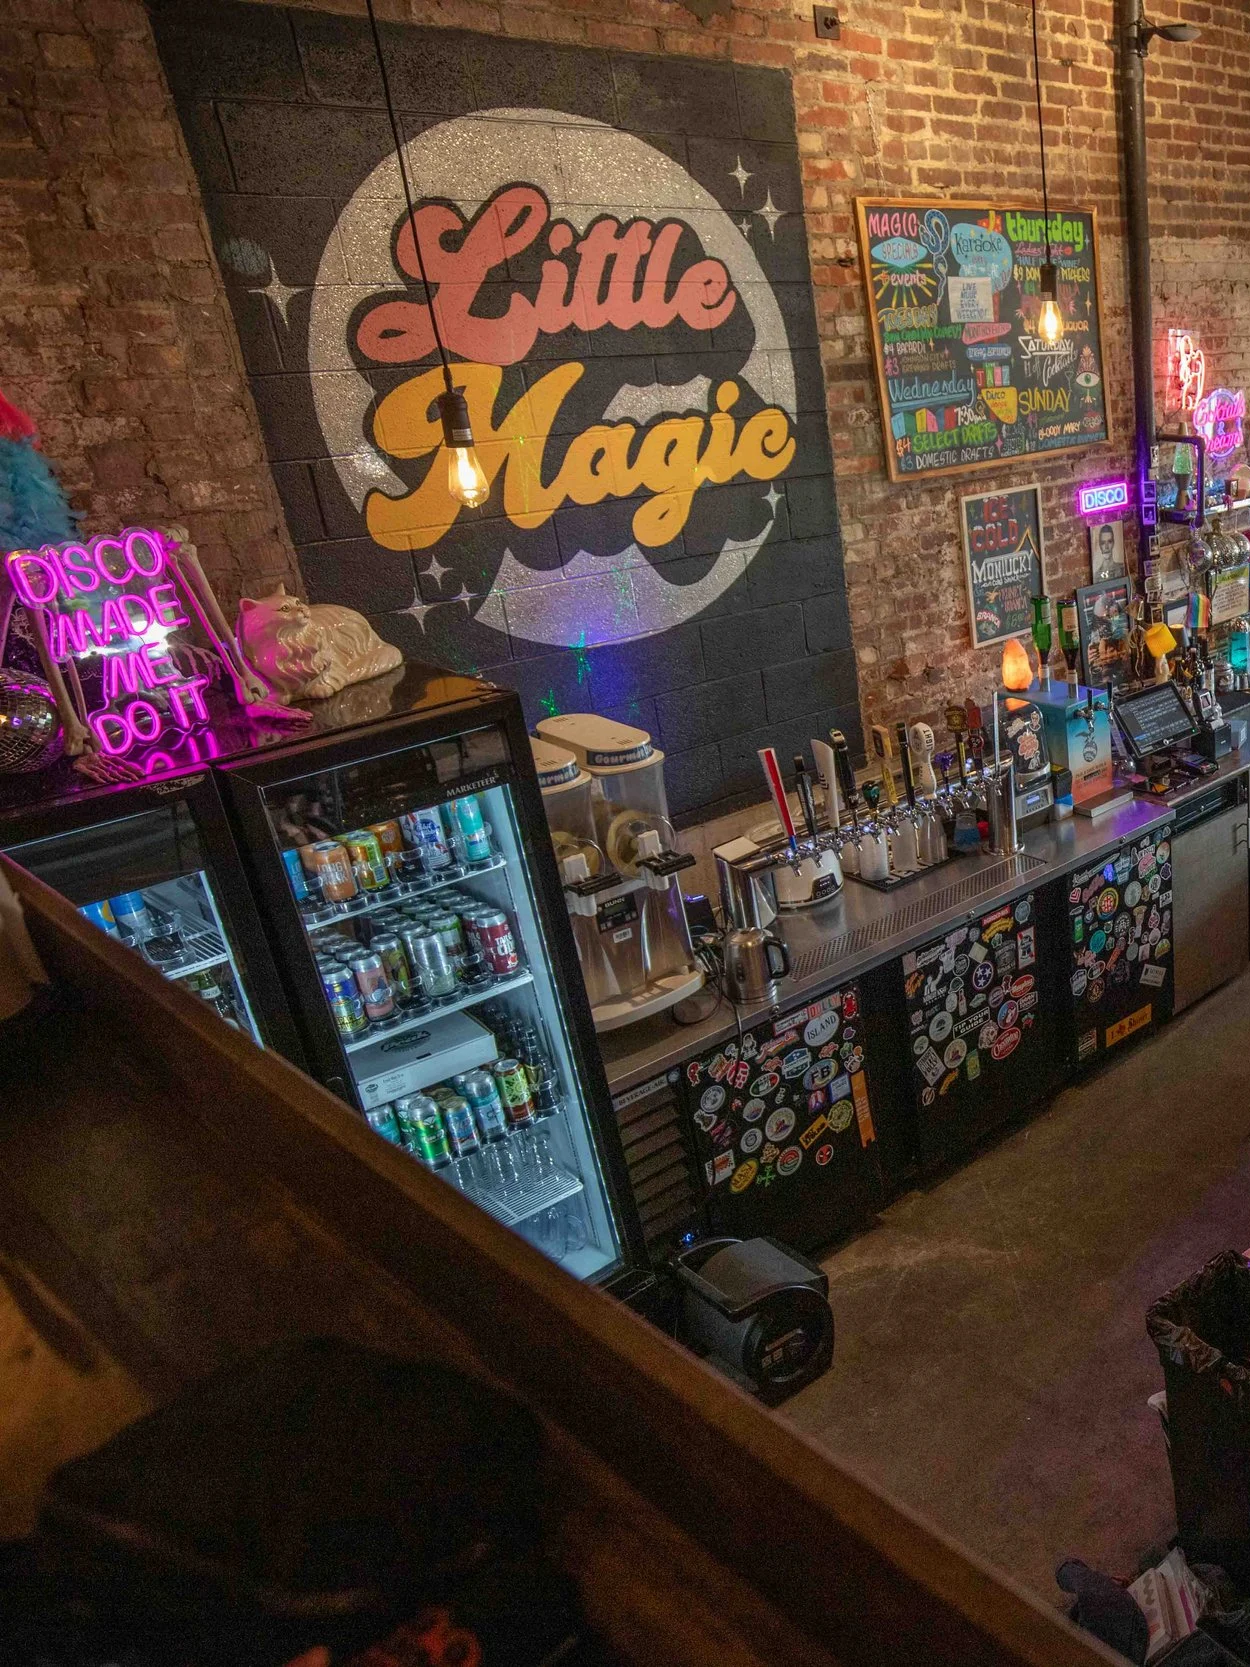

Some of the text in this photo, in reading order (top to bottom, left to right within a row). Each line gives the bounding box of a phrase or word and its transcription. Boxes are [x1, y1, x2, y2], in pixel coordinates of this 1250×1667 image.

[869, 212, 917, 237] MAGIC
[954, 233, 1002, 255] Karaoke
[357, 186, 737, 365] Little
[890, 270, 927, 287] events
[897, 340, 927, 356] BACARDI
[1043, 341, 1078, 387] Cocktails
[888, 368, 975, 407] Wednesday
[1019, 386, 1072, 415] SUNDAY
[912, 429, 959, 455] SELECT
[961, 421, 998, 444] DRAFTS
[365, 362, 797, 552] Magic
[916, 448, 957, 470] DOMESTIC
[961, 446, 995, 462] DRAFTS
[983, 495, 1009, 523] ICE
[1085, 487, 1124, 509] DISCO
[972, 519, 1019, 552] COLD
[8, 531, 164, 604] DISCO
[971, 549, 1034, 584] MONTUCKY
[55, 583, 189, 658] MADE
[109, 642, 181, 698] ME
[94, 677, 208, 755] DO IT
[922, 729, 933, 752] LIGHT
[446, 776, 497, 798] MARKETEER
[807, 1013, 838, 1041] ISLAND
[954, 1009, 990, 1032] TIP YOUR
[960, 1018, 984, 1034] GUIDE
